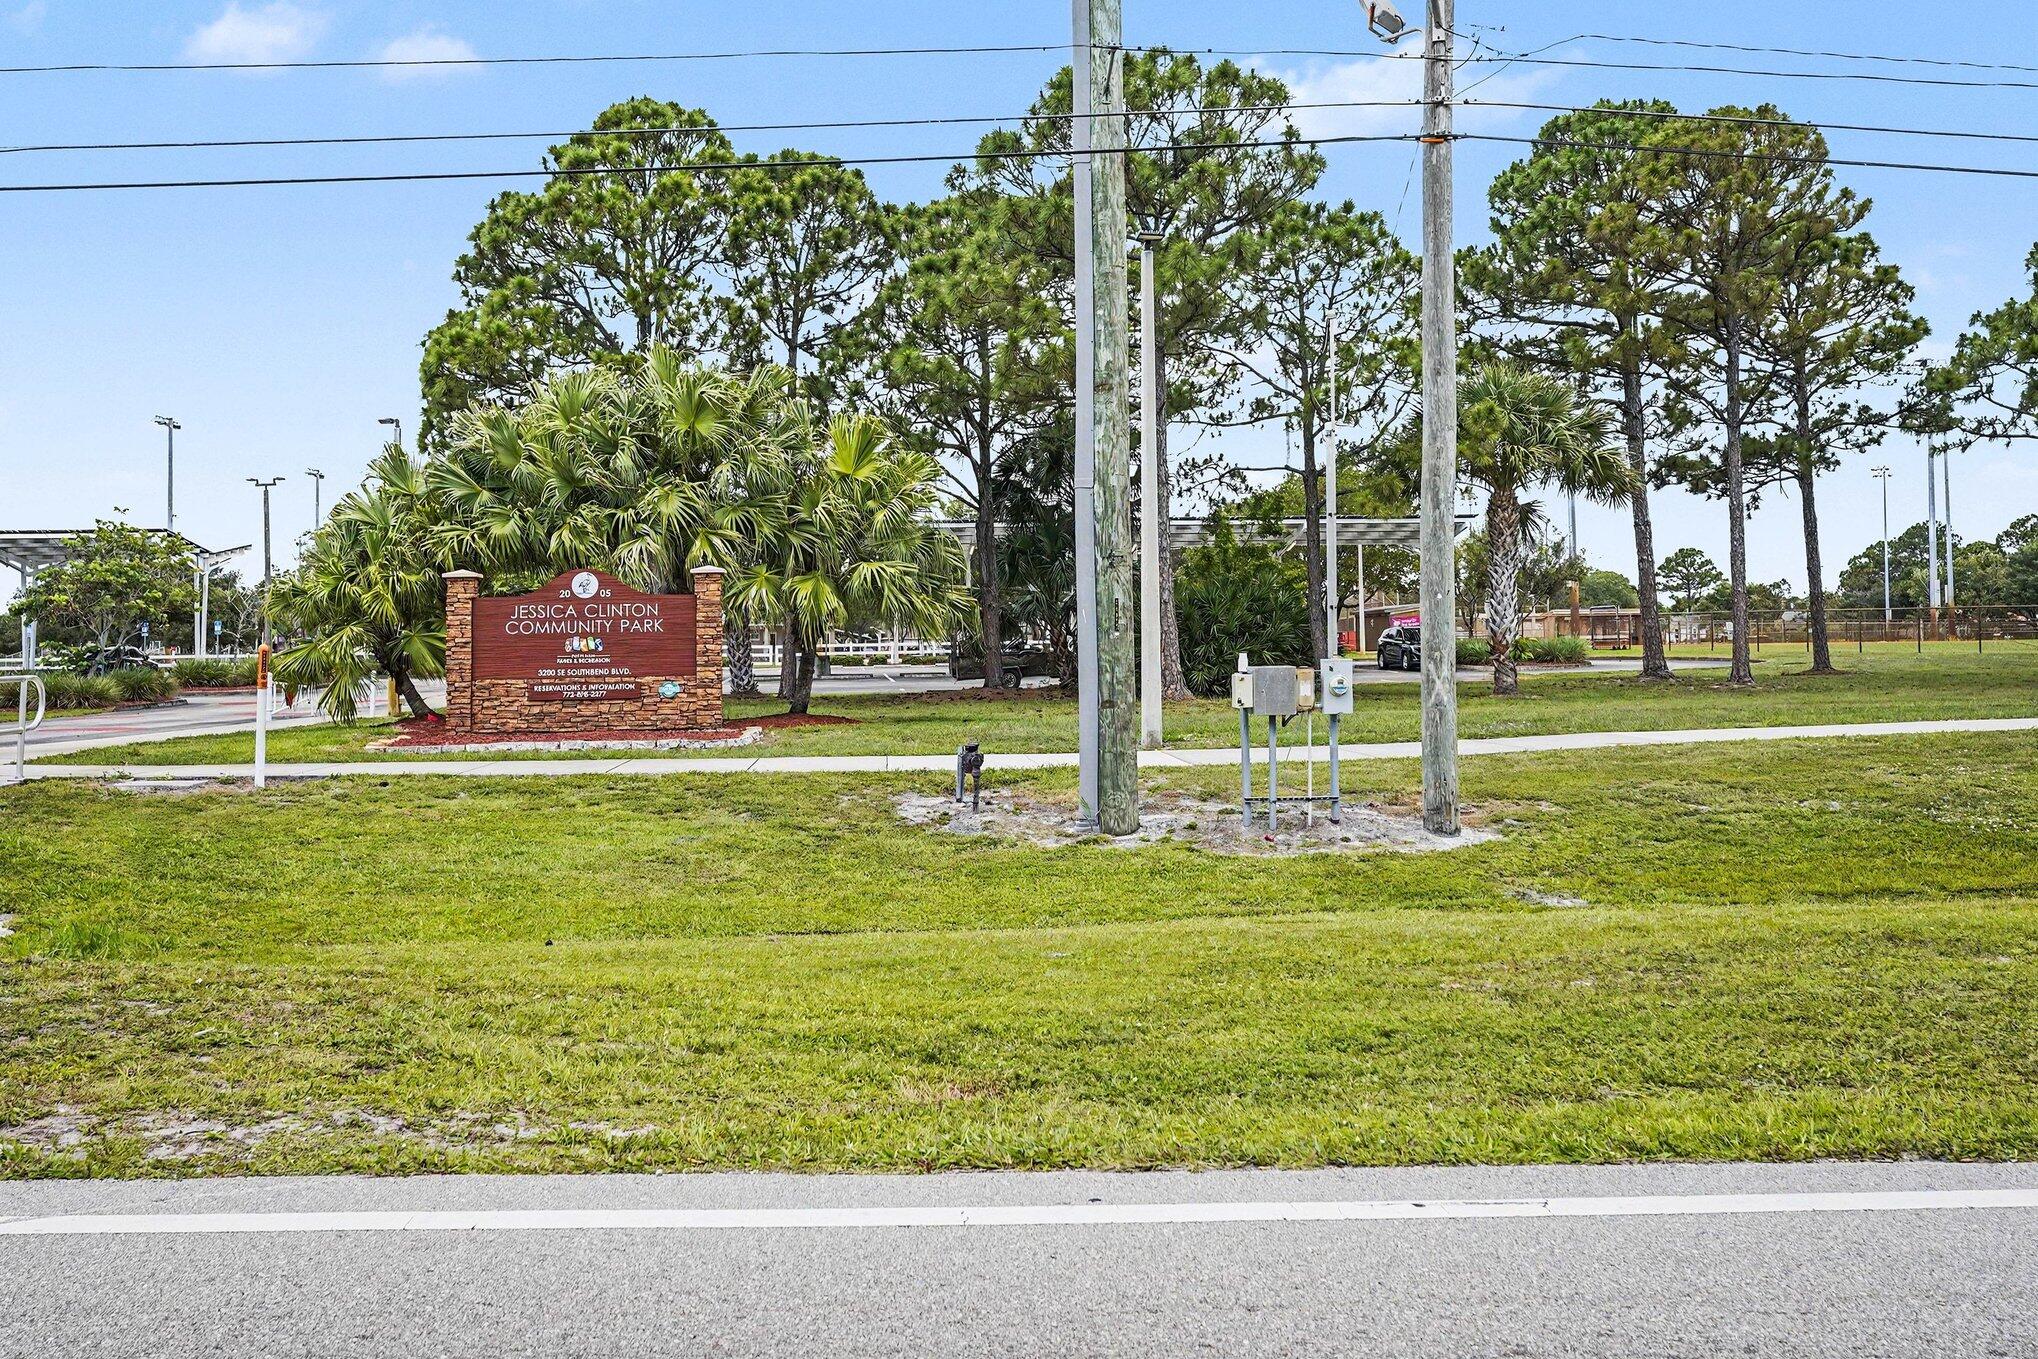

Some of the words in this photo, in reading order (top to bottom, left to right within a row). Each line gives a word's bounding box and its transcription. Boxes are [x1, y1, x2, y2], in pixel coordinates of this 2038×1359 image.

[559, 589, 571, 598] 20
[599, 589, 611, 598] 05
[510, 604, 577, 619] JESSICA
[584, 603, 659, 618] CLINTON
[505, 619, 613, 635] COMMUNITY
[620, 618, 664, 633] PARK
[566, 668, 609, 676] SOUTHBEND
[611, 667, 632, 675] BLVD.
[533, 684, 580, 692] RESERVATIONS
